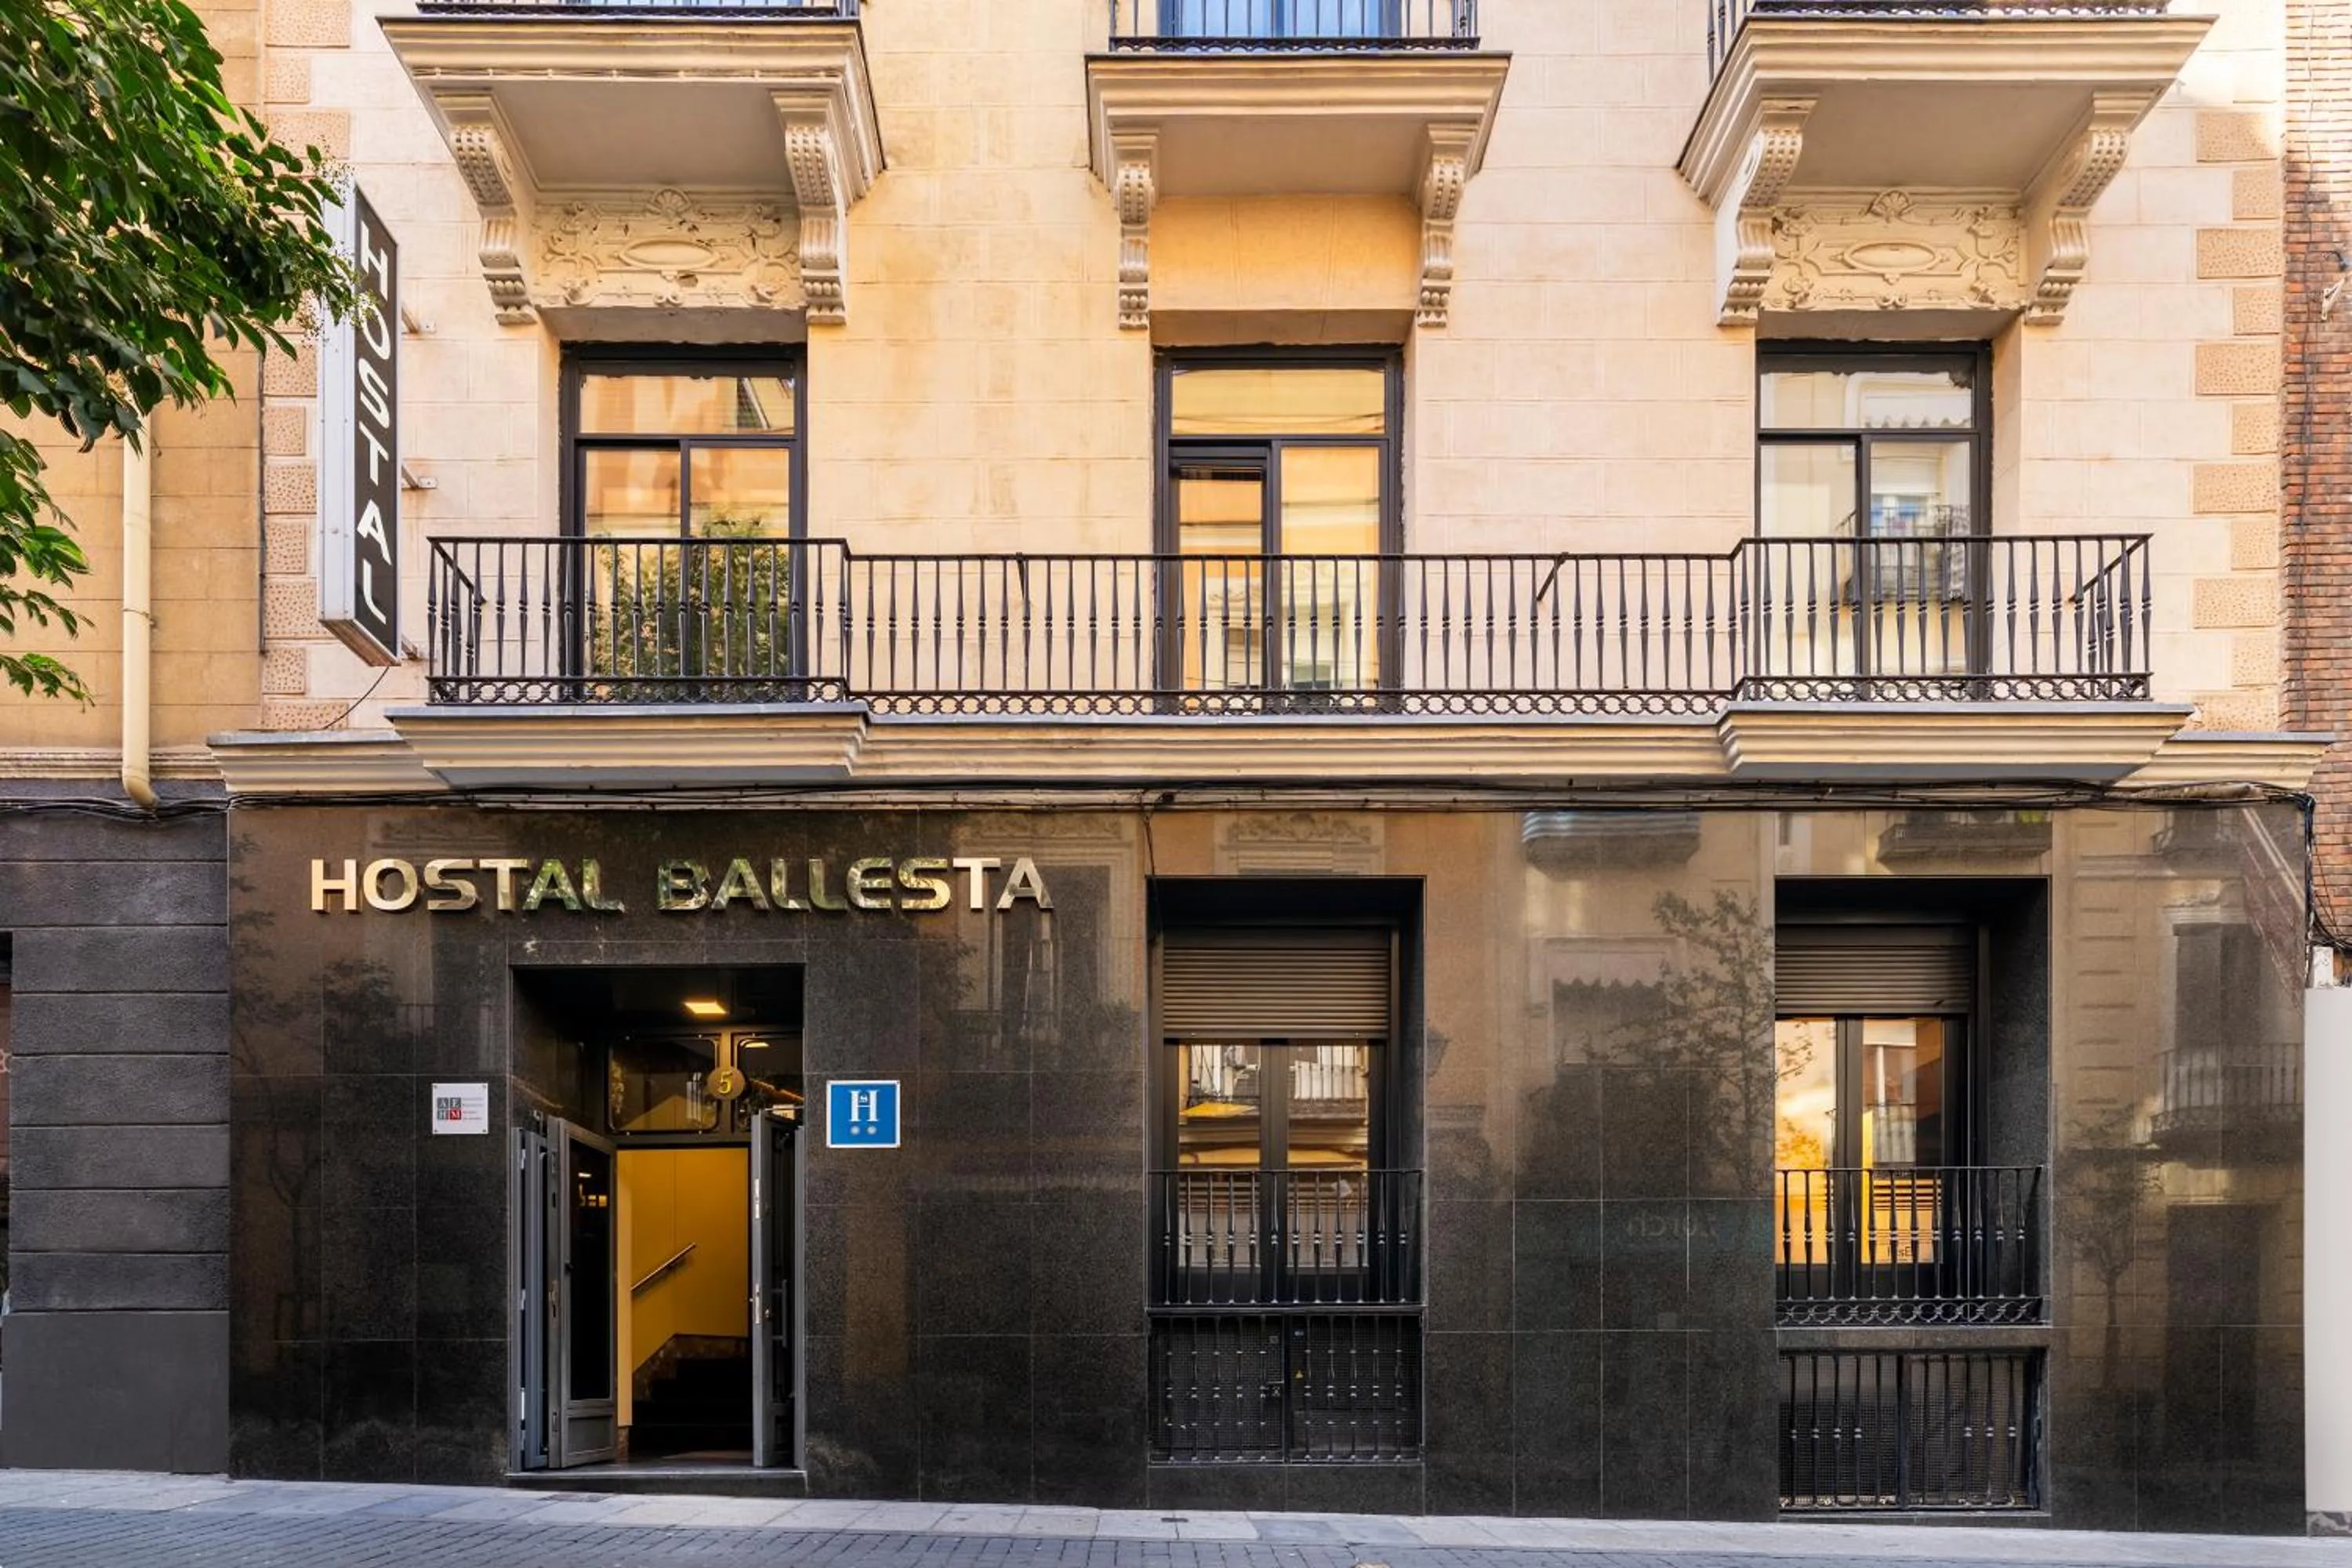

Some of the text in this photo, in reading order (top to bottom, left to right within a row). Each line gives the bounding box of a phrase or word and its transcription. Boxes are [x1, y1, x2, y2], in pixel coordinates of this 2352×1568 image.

[357, 220, 391, 624] HOSTAL
[310, 856, 1054, 914] HOSTAL BALLESTA
[717, 1071, 733, 1094] 5
